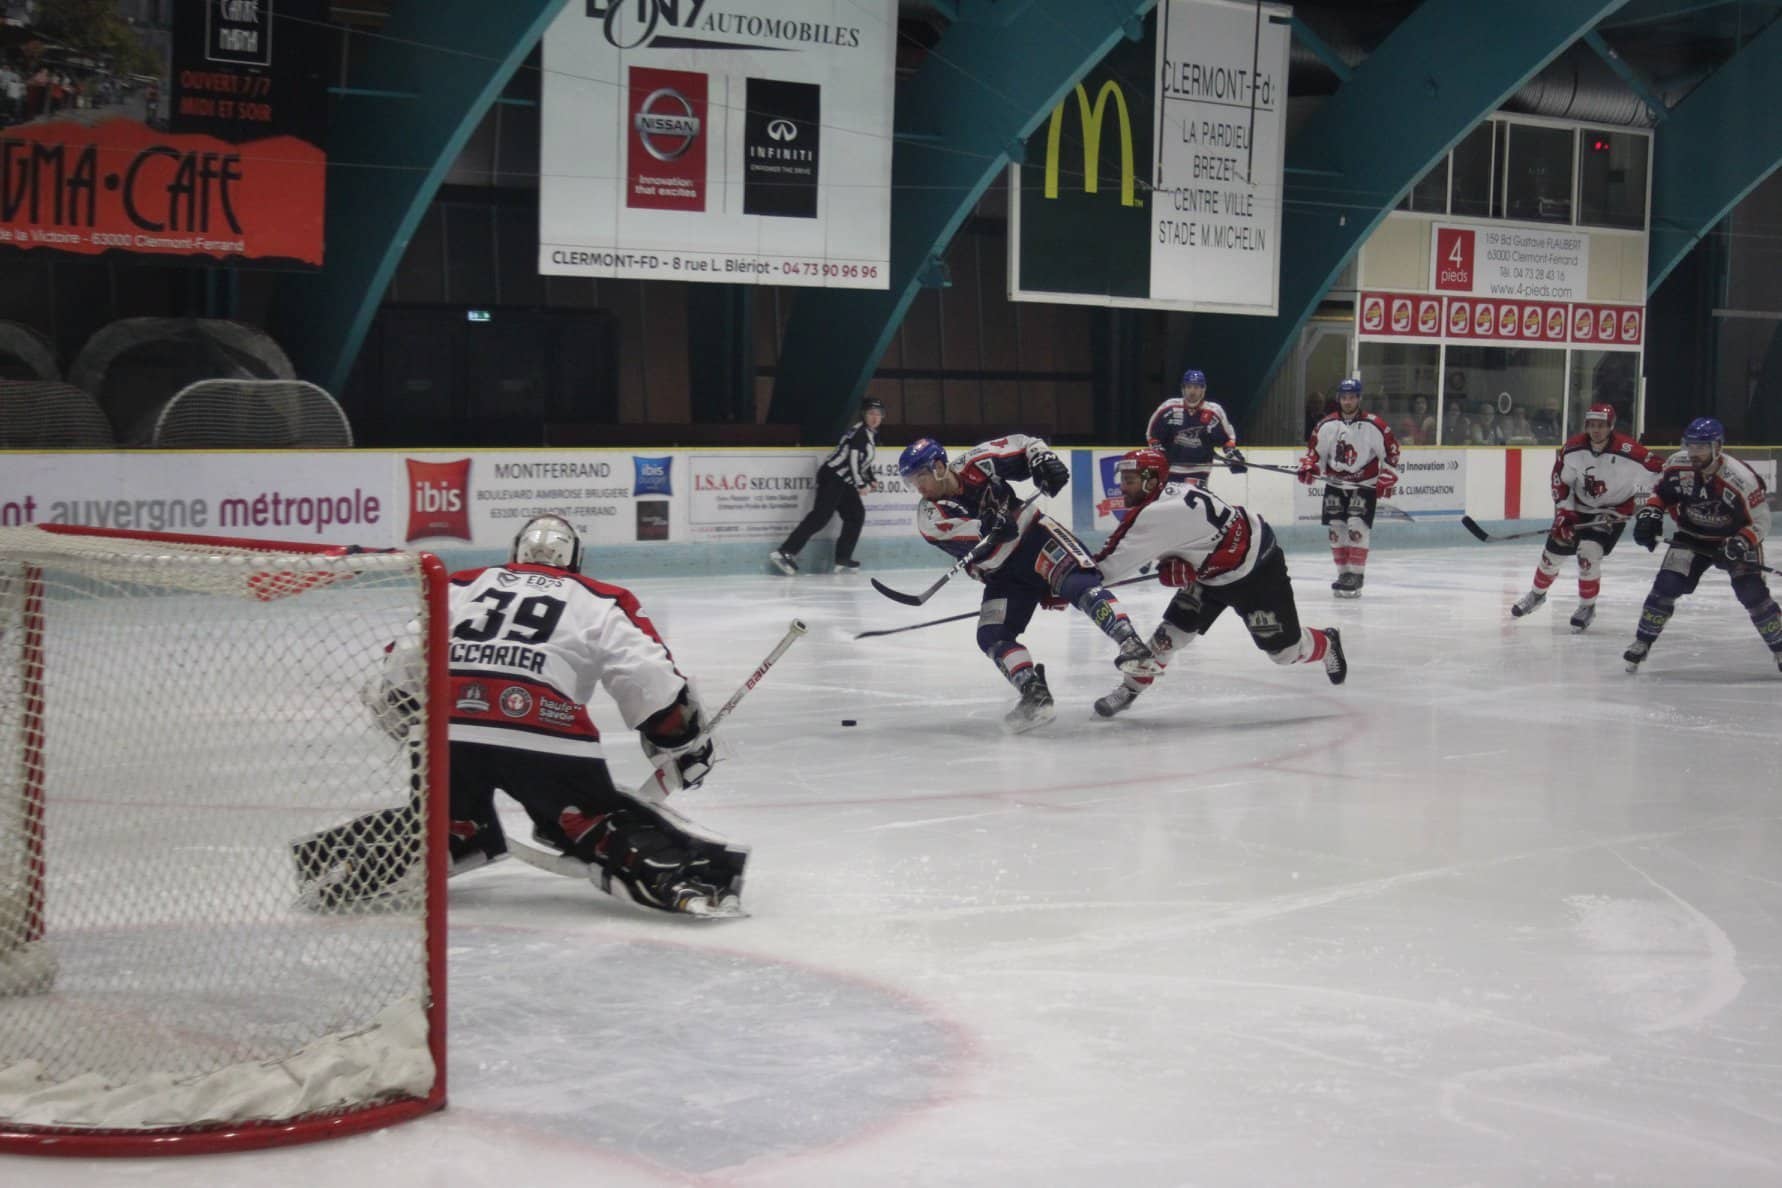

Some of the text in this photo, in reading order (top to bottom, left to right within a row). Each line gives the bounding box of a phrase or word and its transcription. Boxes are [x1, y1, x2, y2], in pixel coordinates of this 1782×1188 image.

[701, 13, 861, 48] AUTOMOBILES
[218, 100, 236, 118] ET
[238, 102, 272, 122] SOIR
[640, 116, 695, 133] NISSAN
[1183, 119, 1250, 150] LA PARDIEU
[750, 146, 812, 161] INFINITI
[639, 174, 693, 188] Innovation
[1193, 154, 1238, 183] BREZET
[634, 184, 697, 199] that excites
[1174, 187, 1254, 217] CENTRE VILLE
[1159, 220, 1266, 251] STADE M.MICHELIN
[552, 250, 659, 269] CLERMONT-FD
[672, 257, 681, 270] 8
[685, 259, 708, 271] rue
[725, 257, 770, 274] Blériot
[783, 262, 800, 275] 04
[803, 263, 819, 276] 73
[822, 264, 839, 277] 90
[842, 265, 858, 278] 96
[861, 266, 878, 279] 96
[1448, 235, 1464, 269] 4
[1440, 268, 1468, 285] pieds
[1490, 283, 1573, 299] www.4-pieds.com
[494, 463, 611, 480] MONTFERRAND
[1406, 460, 1446, 472] Innovation
[476, 488, 533, 501] BOULEVARD
[750, 476, 815, 491] SECURITE
[50, 498, 209, 531] auvergne
[218, 487, 381, 533] métropole
[416, 482, 462, 513] ibis
[452, 587, 567, 645] 39
[449, 642, 547, 675] CCARIER
